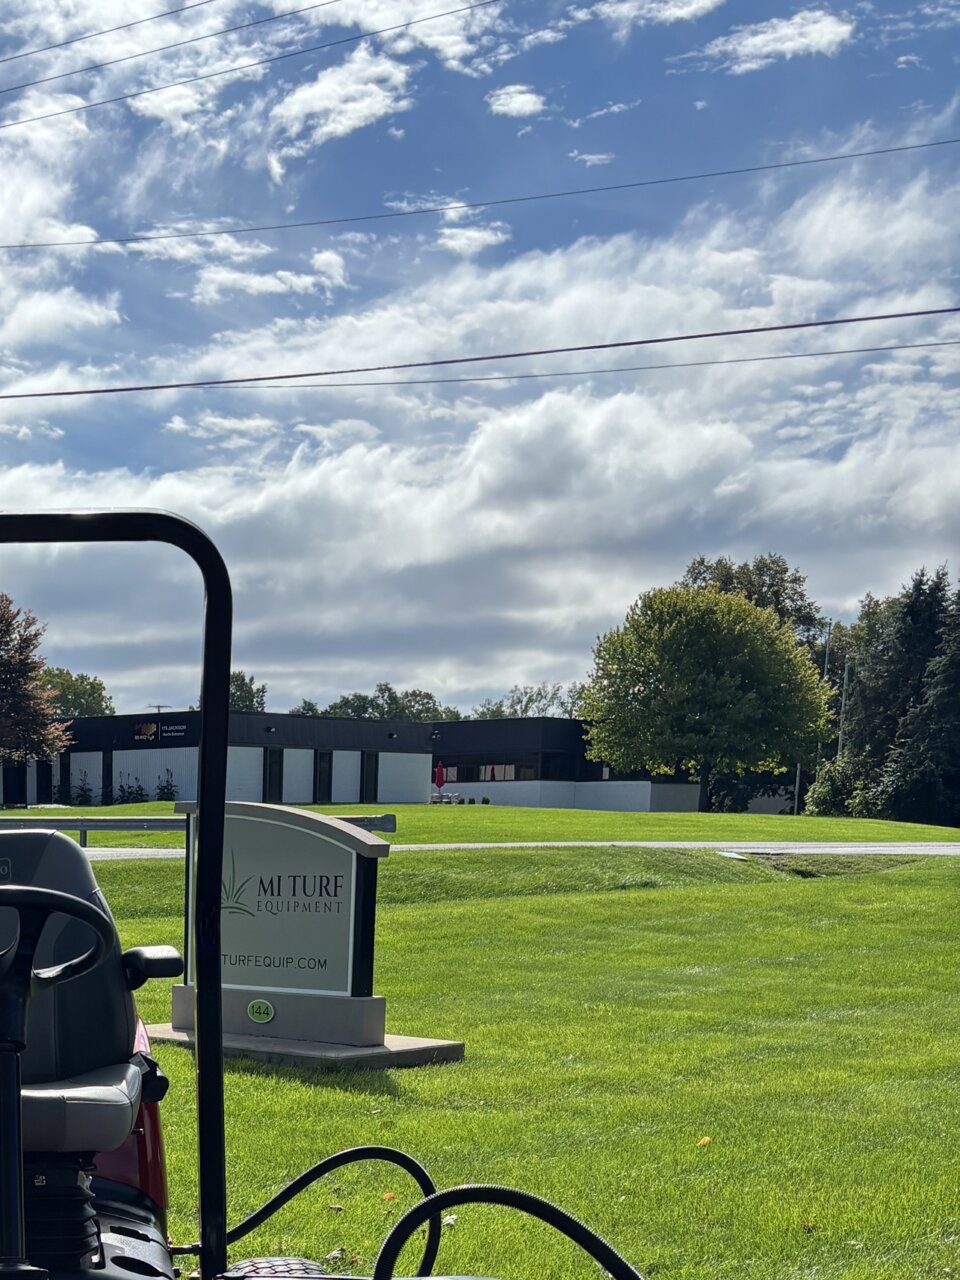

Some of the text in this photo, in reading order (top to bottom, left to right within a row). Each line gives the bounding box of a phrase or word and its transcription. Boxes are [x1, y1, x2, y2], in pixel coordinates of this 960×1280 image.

[257, 875, 344, 898] MI TURF
[257, 900, 343, 916] EQUIPMENT
[251, 1004, 270, 1017] 144
